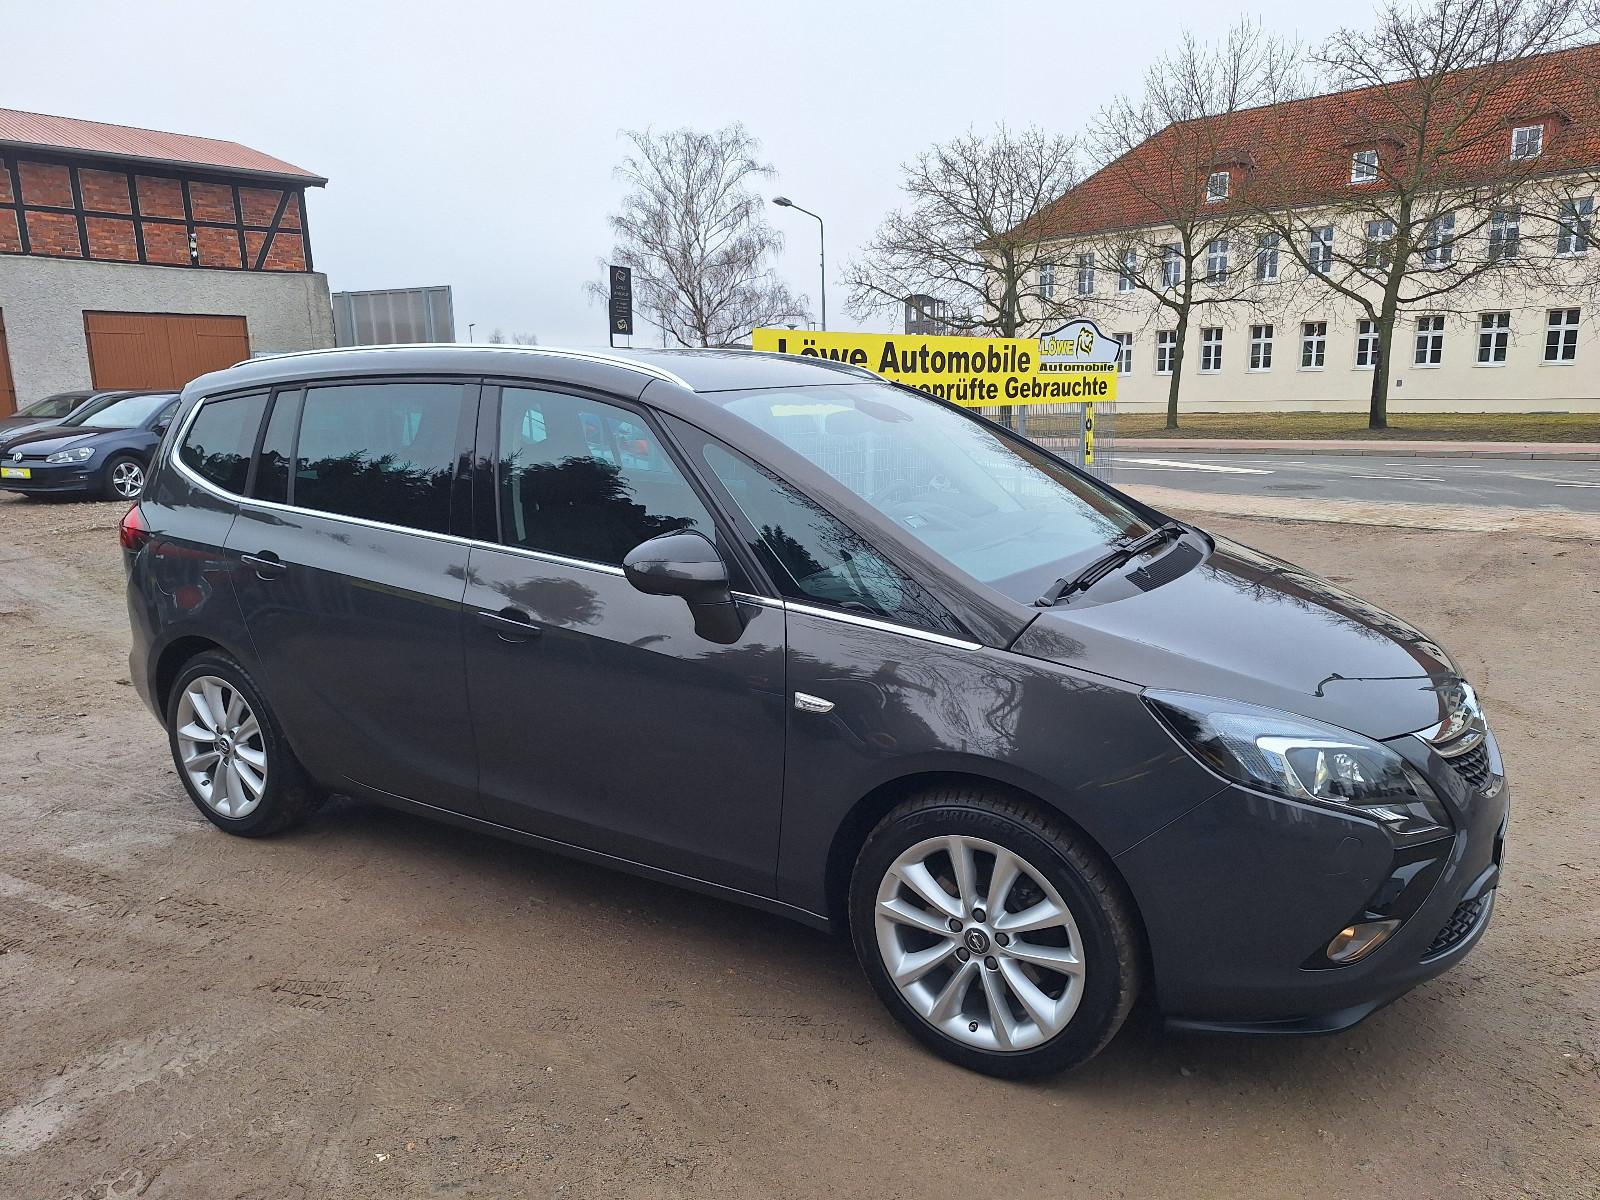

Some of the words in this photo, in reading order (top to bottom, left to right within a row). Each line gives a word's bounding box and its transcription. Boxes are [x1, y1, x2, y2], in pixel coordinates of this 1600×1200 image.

[1040, 336, 1075, 356] LÖWE
[878, 341, 1031, 374] Automobile
[1039, 363, 1115, 372] Automobile
[1004, 376, 1108, 399] Gebrauchte
